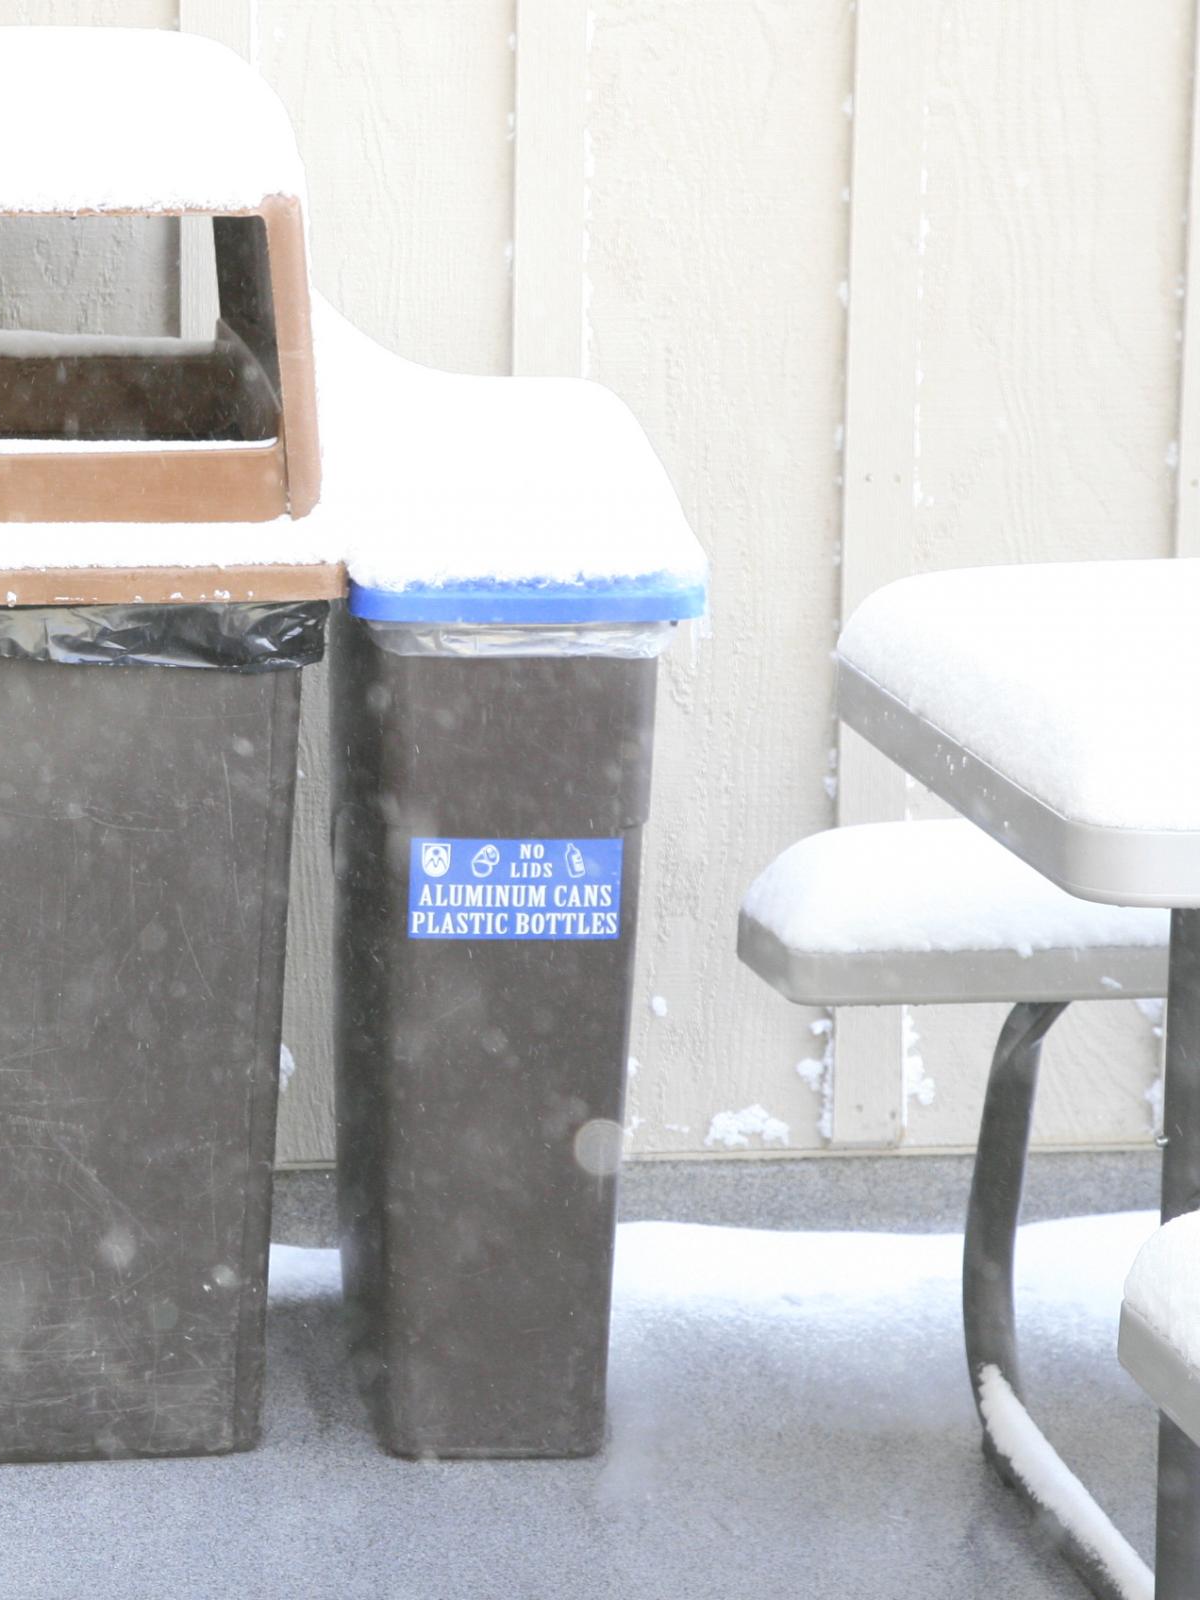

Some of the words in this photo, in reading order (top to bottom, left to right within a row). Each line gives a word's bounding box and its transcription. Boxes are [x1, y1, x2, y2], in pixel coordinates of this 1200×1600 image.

[519, 843, 545, 859] NO
[509, 862, 553, 879] LIDS
[418, 884, 547, 908] ALUMINUM
[554, 884, 612, 908] CANS
[410, 911, 508, 935] PLASTIC
[514, 912, 618, 935] BOTTLES
